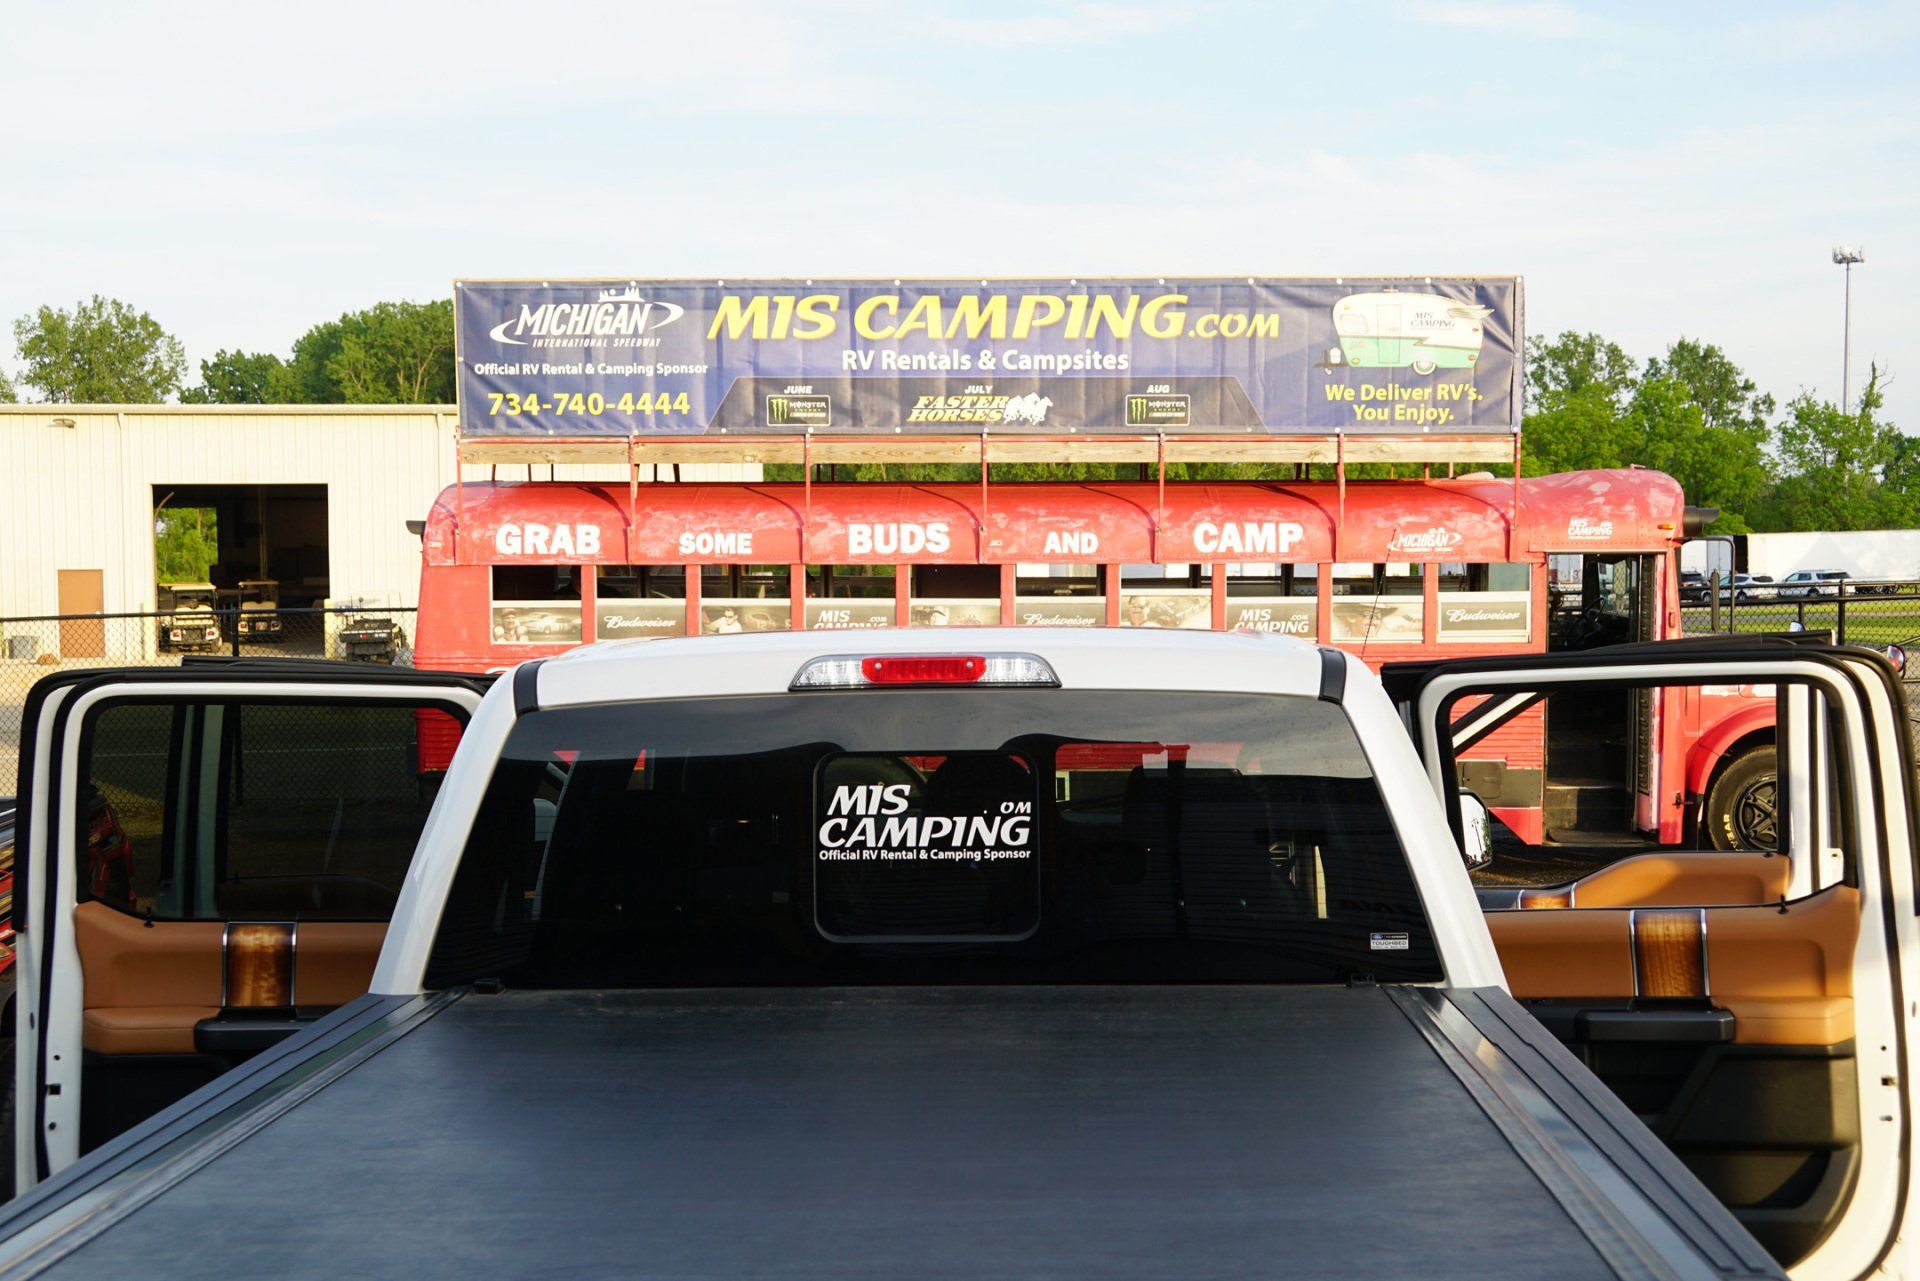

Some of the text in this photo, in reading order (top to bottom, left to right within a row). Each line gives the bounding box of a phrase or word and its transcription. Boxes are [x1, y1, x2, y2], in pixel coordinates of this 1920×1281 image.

[514, 303, 653, 336] MICHIGAN
[707, 294, 840, 340] MIS
[532, 337, 661, 348] INTERNATIONAL SPEEDWAY
[474, 362, 708, 378] Official RV Rental & Camping Sponsor
[842, 350, 1129, 375] RV Rentals & Campsites
[784, 385, 813, 394] JUNE
[964, 385, 993, 394] JULY
[1146, 384, 1170, 394] AUG
[1325, 384, 1355, 401] We
[1360, 384, 1432, 401] Deliver
[487, 391, 691, 416] 734-740-4444
[789, 401, 827, 409] MONSTER
[914, 395, 1010, 409] FASTER
[1148, 400, 1186, 408] MONSTER
[906, 408, 1005, 422] HORSES
[1353, 404, 1454, 424] You Enjoy.
[495, 523, 601, 555] GRAB
[678, 532, 752, 554] SOME
[848, 522, 950, 554] BUDS
[1044, 531, 1098, 554] AND
[1193, 522, 1303, 553] CAMP
[1397, 533, 1449, 548] MICHIGAN
[604, 615, 677, 629] Budweiser
[817, 610, 850, 622] MIS
[1023, 613, 1096, 626] Budweiser
[1239, 609, 1271, 621] MIS
[1447, 608, 1520, 623] Budweiser
[1235, 620, 1310, 634] CAMPING
[827, 785, 911, 816] MIS
[819, 816, 1031, 848] CAMPING
[819, 849, 1031, 862] Official RV Rental & Camping Sponsor
